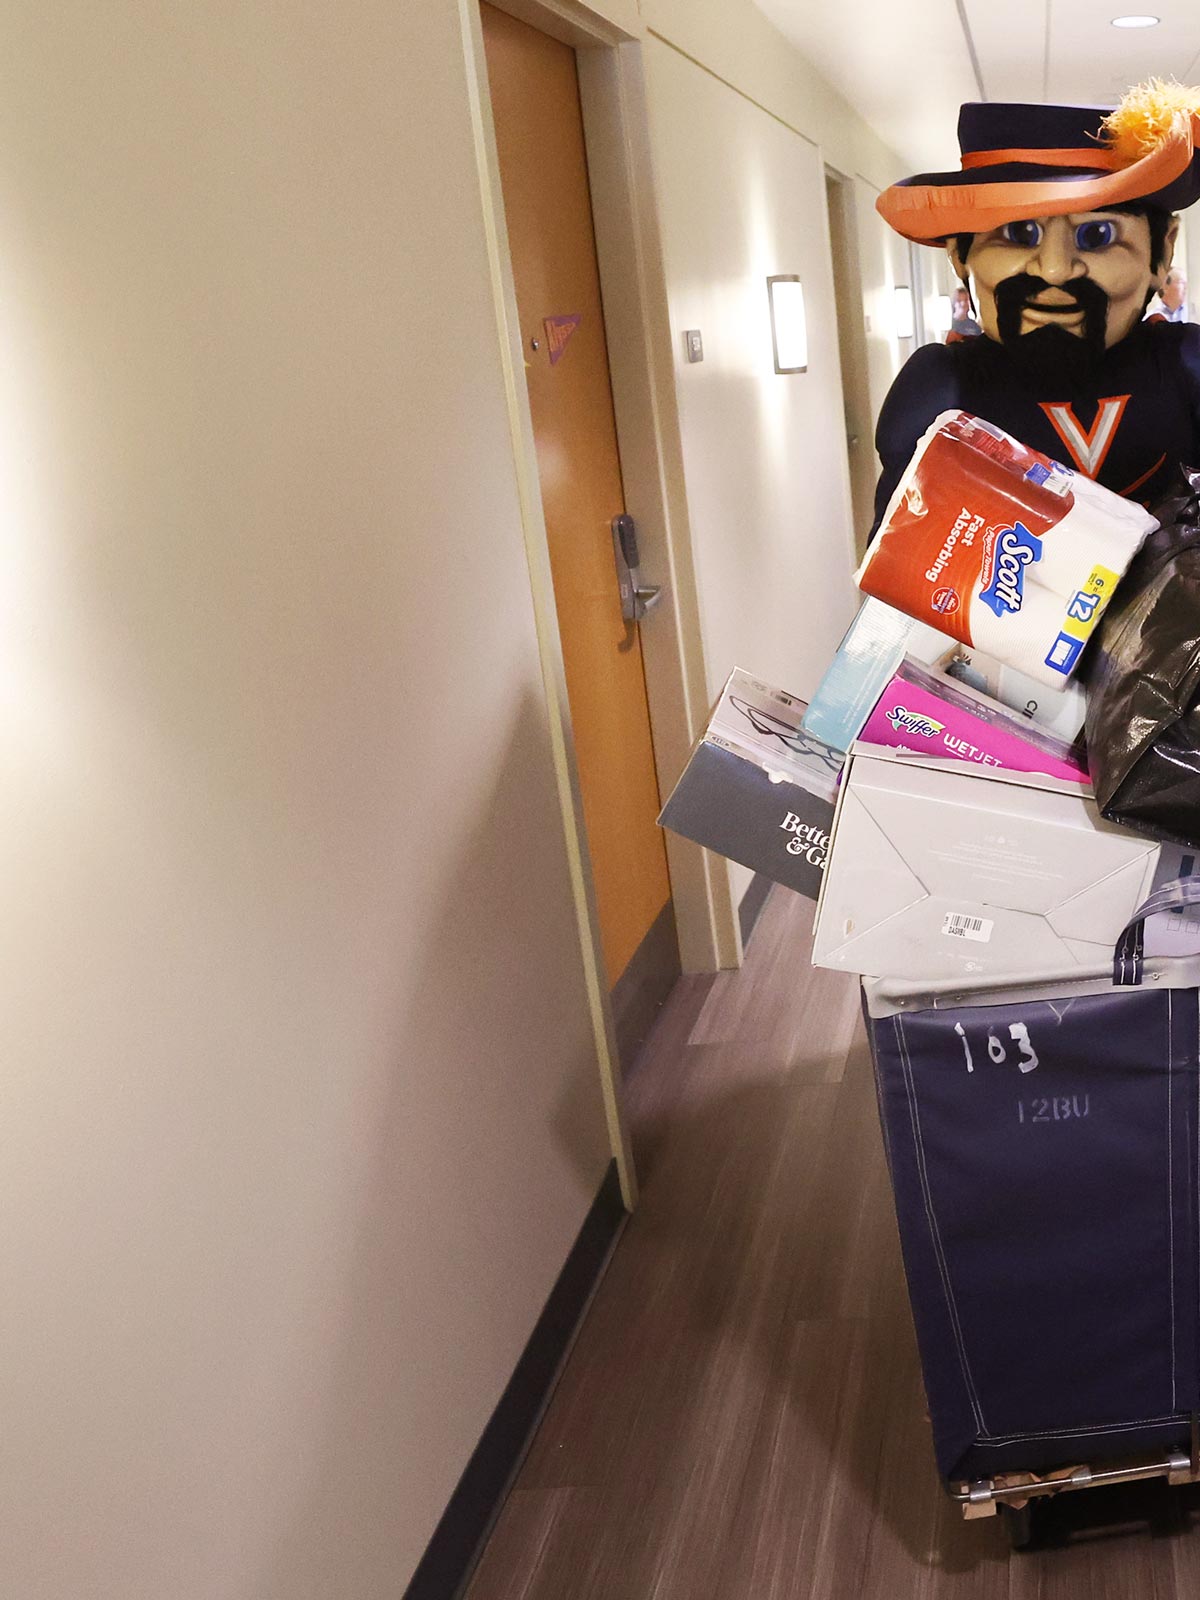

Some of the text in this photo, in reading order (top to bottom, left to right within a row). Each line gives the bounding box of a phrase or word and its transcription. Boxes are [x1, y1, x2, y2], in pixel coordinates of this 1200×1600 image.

[1037, 395, 1132, 480] V
[925, 507, 974, 583] Absorbing
[961, 513, 986, 547] Fast
[995, 532, 1034, 612] Scott
[1068, 590, 1101, 623] 12
[886, 706, 940, 739] Swiffer
[954, 1022, 1039, 1074] 103
[1018, 1094, 1089, 1124] 12BU
